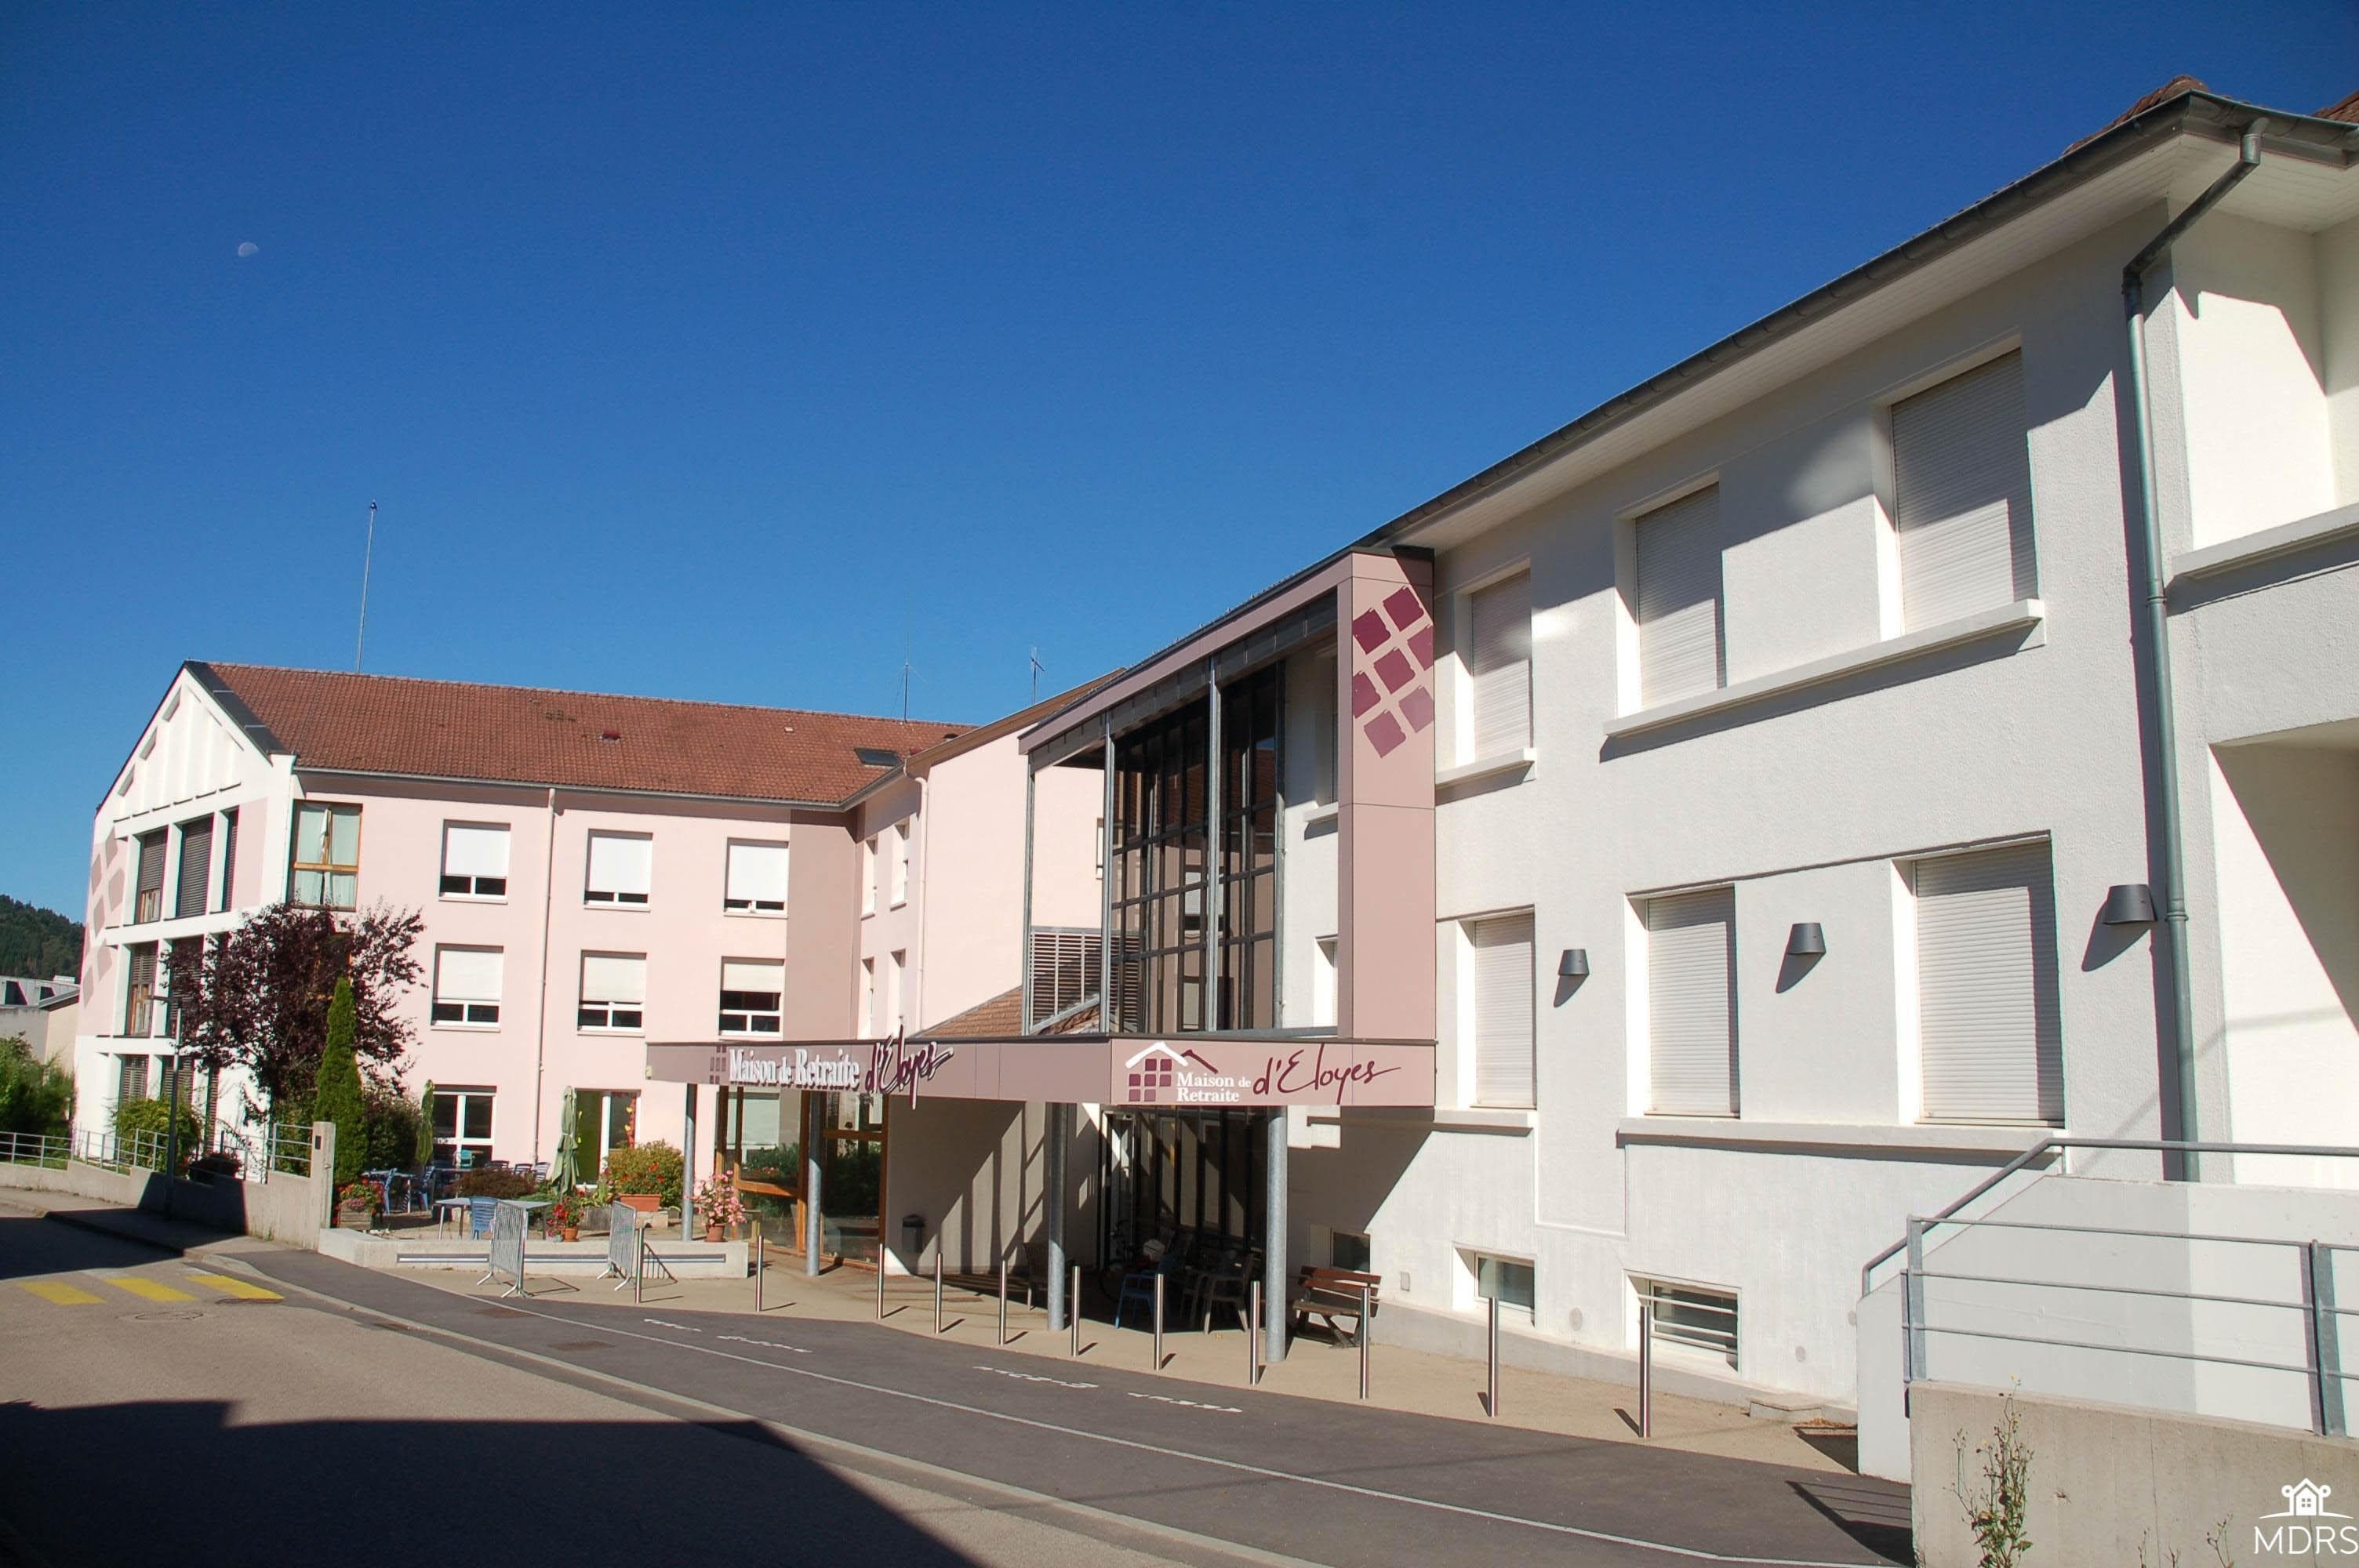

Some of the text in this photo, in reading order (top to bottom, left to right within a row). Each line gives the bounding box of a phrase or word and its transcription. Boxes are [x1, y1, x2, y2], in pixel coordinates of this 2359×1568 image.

[729, 1024, 954, 1109] Maison de Retraite d'Eloyes
[1176, 1072, 1252, 1087] Maison de
[1253, 1043, 1401, 1105] d'Eloyes
[1176, 1087, 1240, 1102] Retraite
